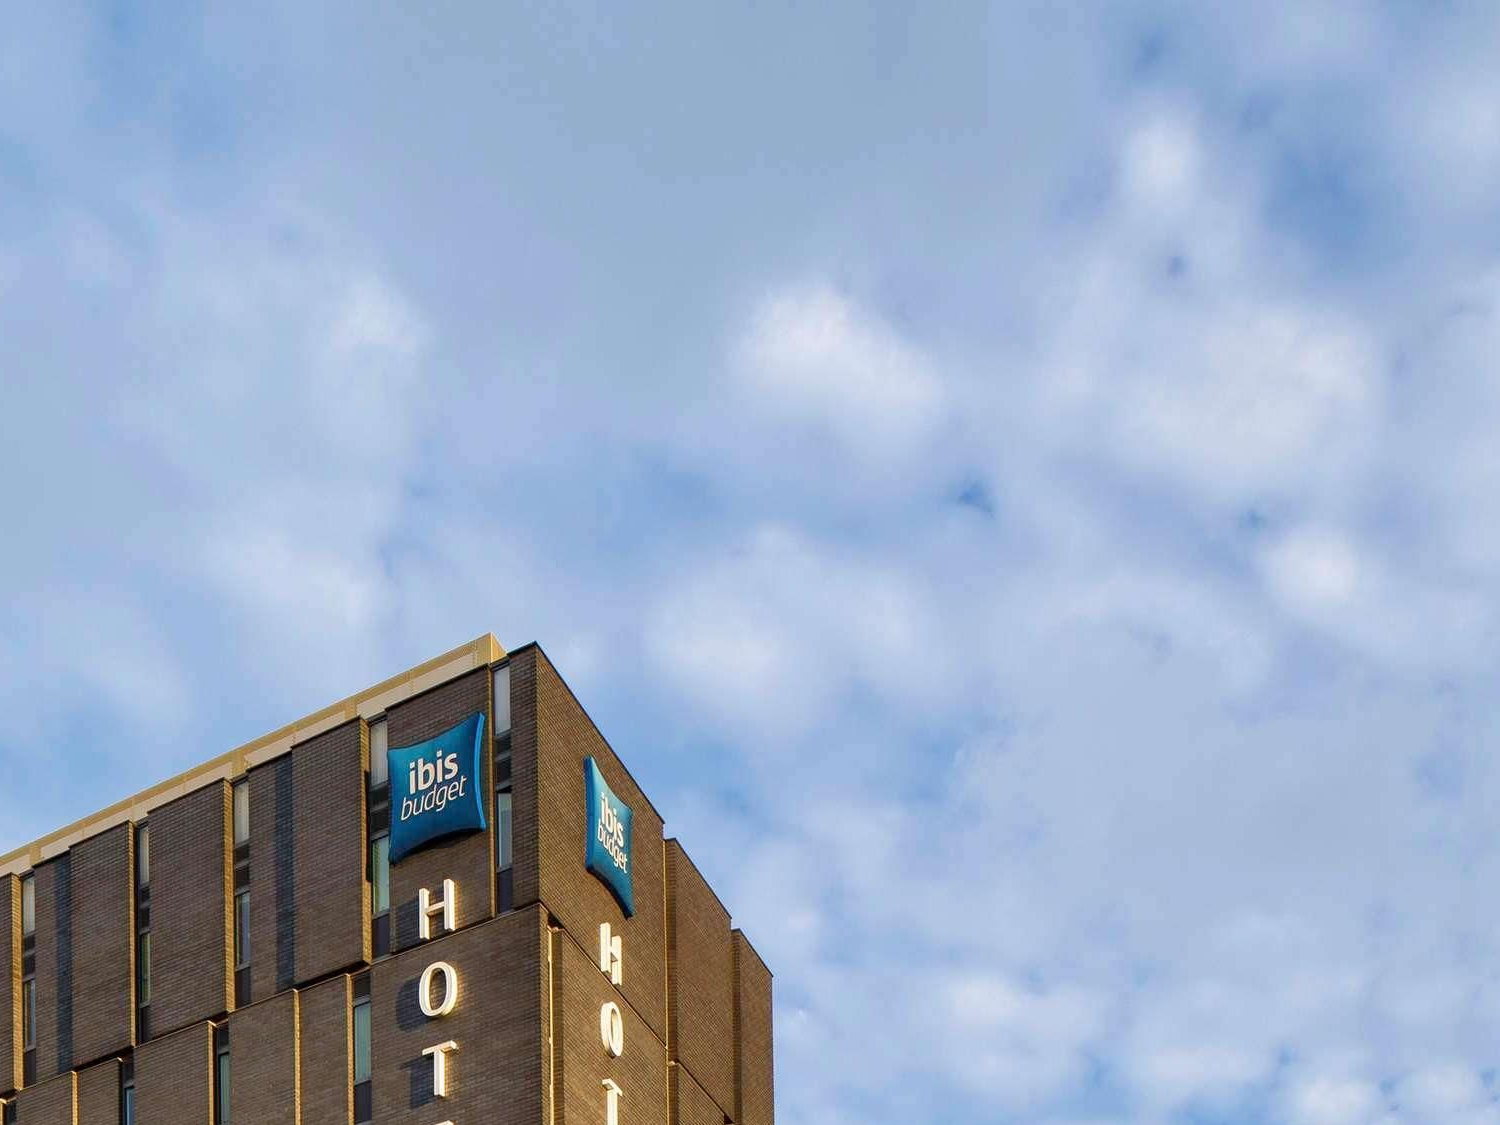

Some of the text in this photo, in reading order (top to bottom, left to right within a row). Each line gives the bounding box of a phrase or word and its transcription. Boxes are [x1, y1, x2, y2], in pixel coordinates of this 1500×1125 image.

[401, 775, 467, 821] budget
[409, 750, 459, 795] ibis
[599, 792, 625, 848] ibis
[597, 818, 628, 874] budget
